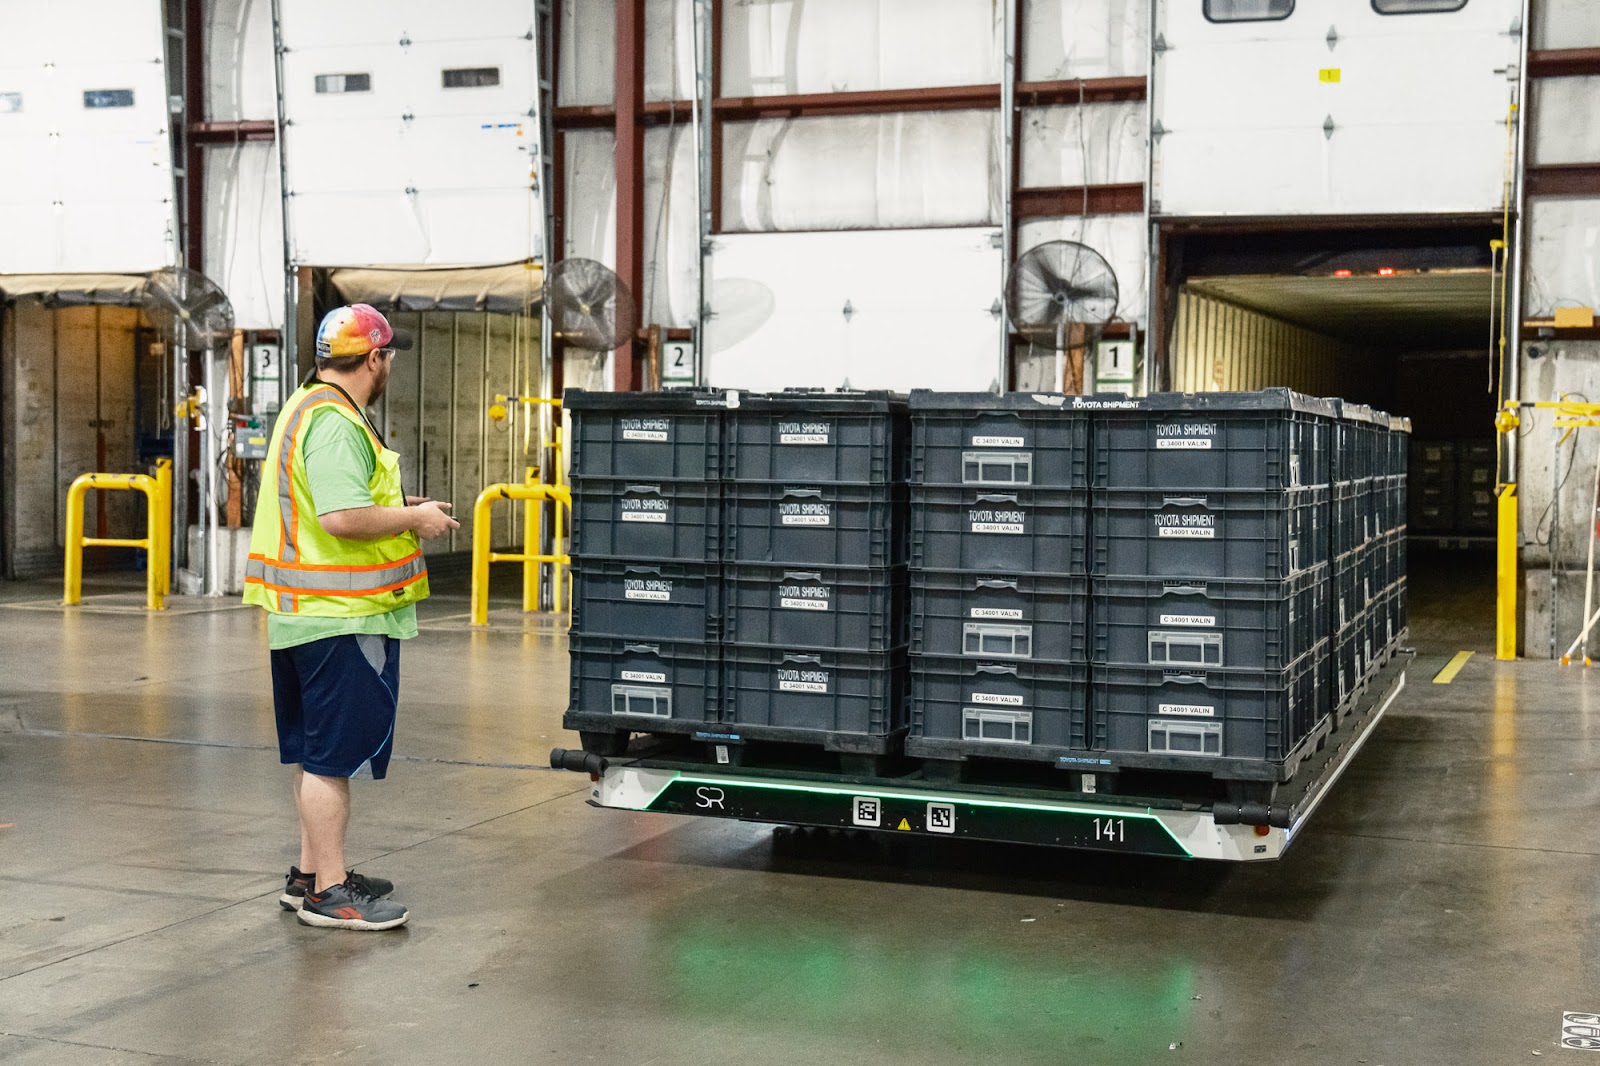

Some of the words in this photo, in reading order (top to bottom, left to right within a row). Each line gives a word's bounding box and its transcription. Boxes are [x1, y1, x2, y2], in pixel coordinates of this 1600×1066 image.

[262, 349, 270, 368] 3
[674, 346, 684, 367] 2
[1109, 346, 1118, 368] 1
[1072, 401, 1101, 409] TOYOTA
[1102, 401, 1140, 409] SHIPMENT
[621, 419, 642, 430] TOYOTA
[642, 419, 670, 430] SHIPMENT
[778, 422, 801, 434] TOYOTA
[801, 423, 830, 434] SHIPMENT
[1156, 424, 1182, 436] TOYOTA
[1183, 423, 1217, 436] SHIPMENT
[621, 498, 642, 510] TOYOTA
[642, 498, 669, 510] SHIPMENT
[778, 503, 801, 515] TOYOTA
[801, 503, 831, 515] SHIPMENT
[969, 510, 992, 522] TOYOTA
[994, 510, 1026, 523] SHIPMENT
[1154, 514, 1180, 526] TOYOTA
[1181, 514, 1215, 526] SHIPMENT
[624, 579, 645, 590] TOYOTA
[645, 580, 673, 592] SHIPMENT
[778, 585, 801, 597] TOYOTA
[801, 586, 831, 598] SHIPMENT
[777, 669, 800, 680] TOYOTA
[800, 670, 829, 683] SHIPMENT
[695, 786, 725, 810] SR
[1093, 817, 1124, 842] 141
